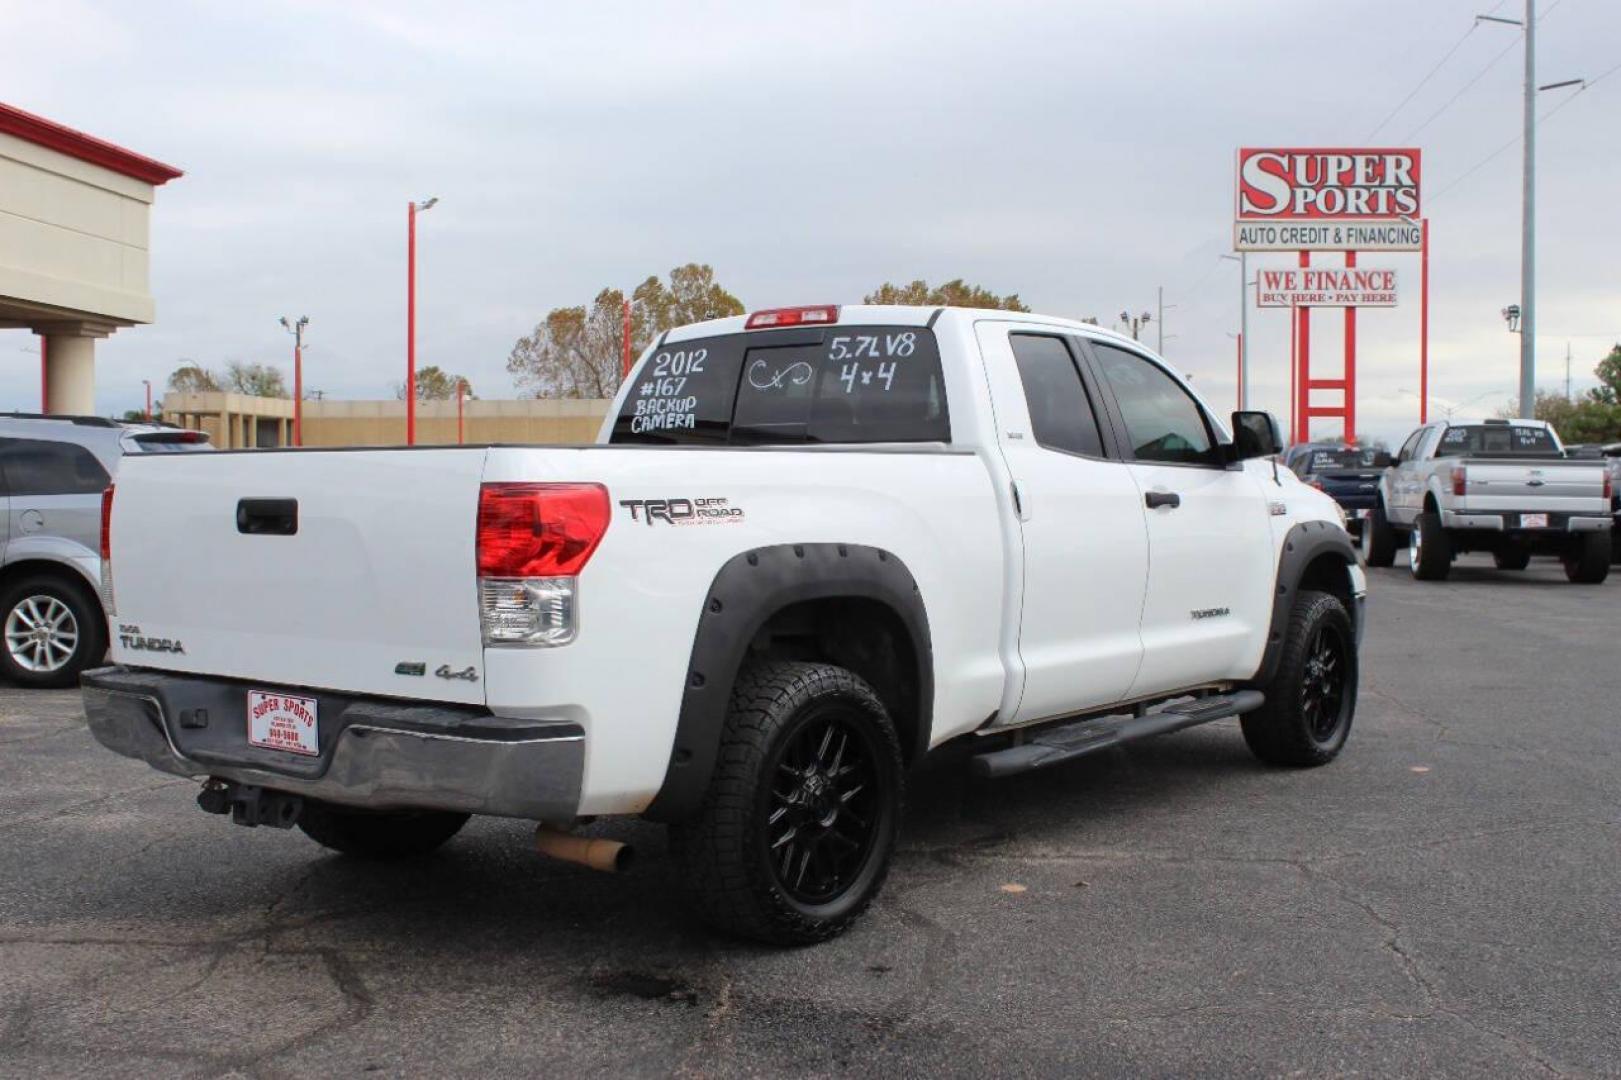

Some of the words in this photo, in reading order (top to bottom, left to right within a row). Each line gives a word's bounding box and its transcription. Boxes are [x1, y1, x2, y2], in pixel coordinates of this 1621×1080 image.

[1240, 228, 1276, 244] AUTO
[1280, 227, 1329, 244] CREDIT
[1334, 227, 1342, 244] &
[1346, 227, 1420, 244] FINANCING
[1263, 270, 1297, 291] WE
[1303, 270, 1395, 291] FINANCE
[1263, 293, 1287, 302] BUY
[1292, 293, 1326, 302] HERE
[1336, 293, 1358, 302] PAY
[1362, 293, 1396, 302] HERE
[653, 349, 707, 377] 2012
[640, 377, 687, 396] #167
[840, 362, 897, 393] 4x4
[634, 396, 696, 416] BACKUP
[631, 413, 695, 433] CAMERA
[619, 499, 694, 526] TRD
[697, 508, 743, 517] ROAD
[120, 635, 186, 655] TUNDRA
[253, 699, 279, 719] SUPER
[283, 699, 314, 728] SPORTS
